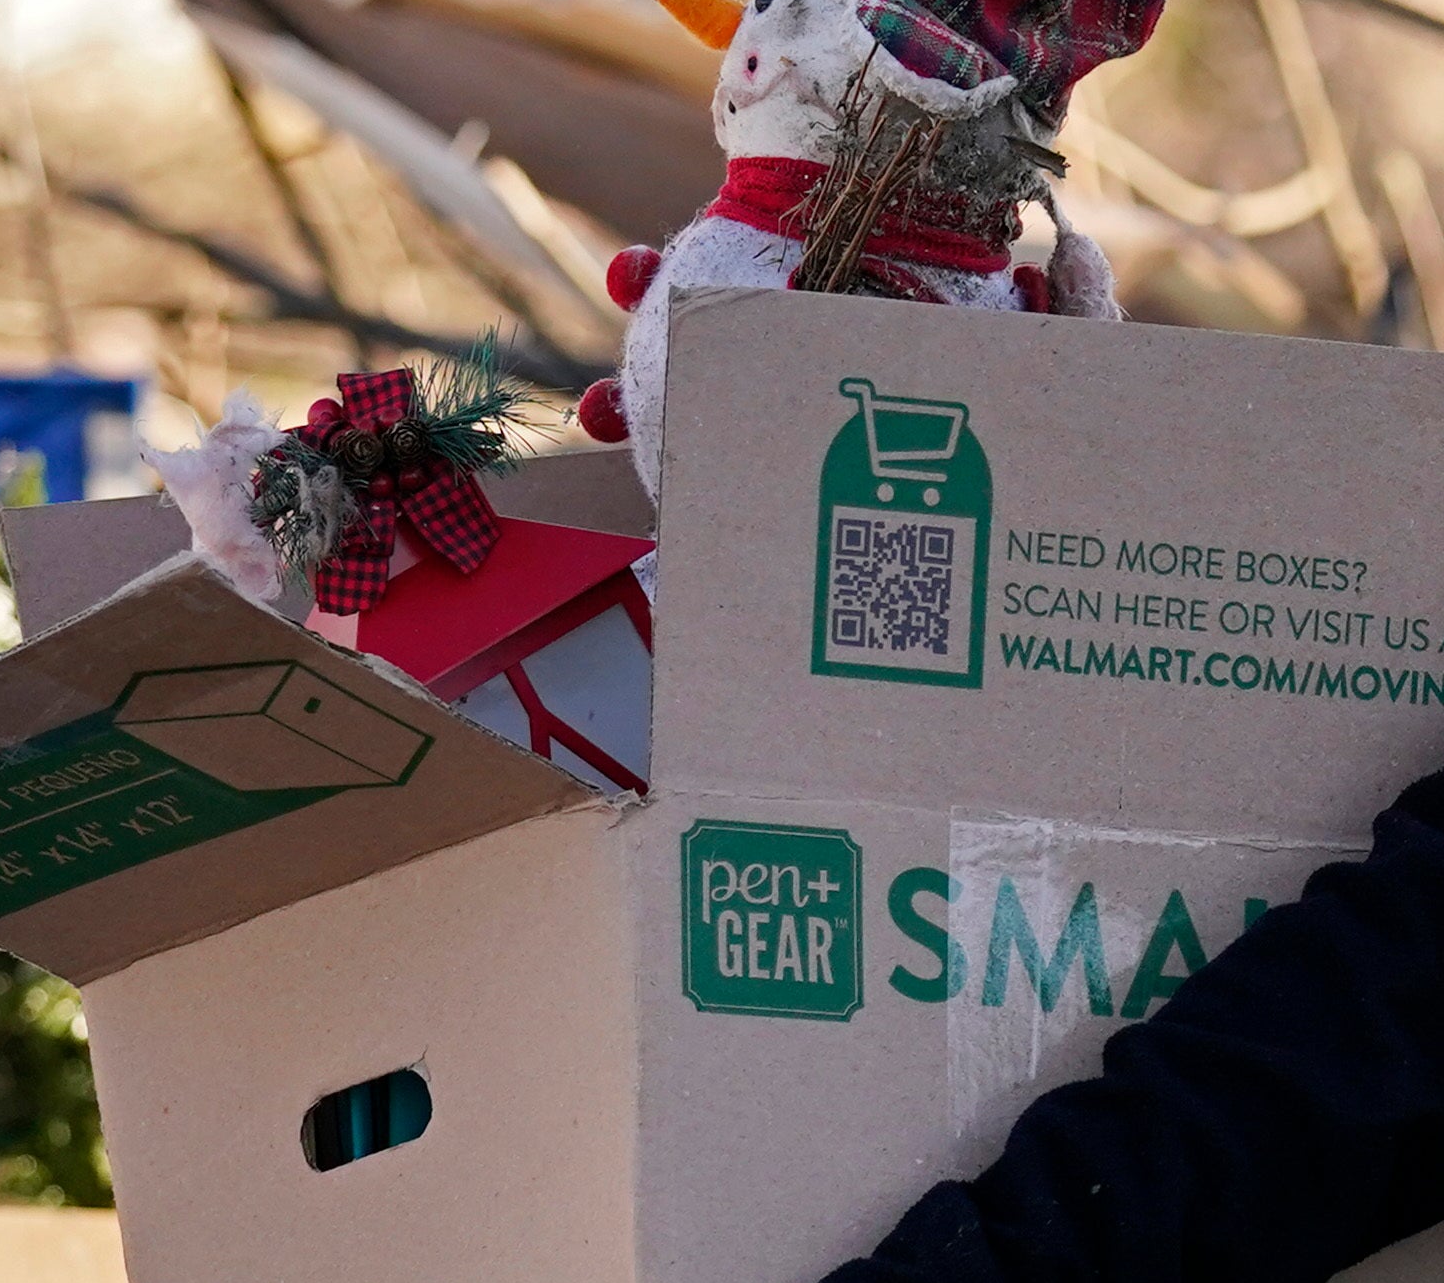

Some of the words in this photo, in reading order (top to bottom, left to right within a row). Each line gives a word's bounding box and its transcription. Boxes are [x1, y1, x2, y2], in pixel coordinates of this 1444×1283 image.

[1007, 529, 1106, 568] NEED
[1116, 539, 1226, 580] MORE
[1236, 551, 1368, 593] BOXES?
[1003, 582, 1103, 623] SCAN
[1114, 592, 1209, 632] HERE
[1219, 601, 1275, 638] OR
[1286, 606, 1374, 648] VISIT
[1385, 616, 1430, 652] US
[8, 748, 142, 803] PEQUEÑO
[701, 855, 840, 925] pen+
[717, 909, 835, 985] GEAR
[887, 867, 1269, 1018] SMA
